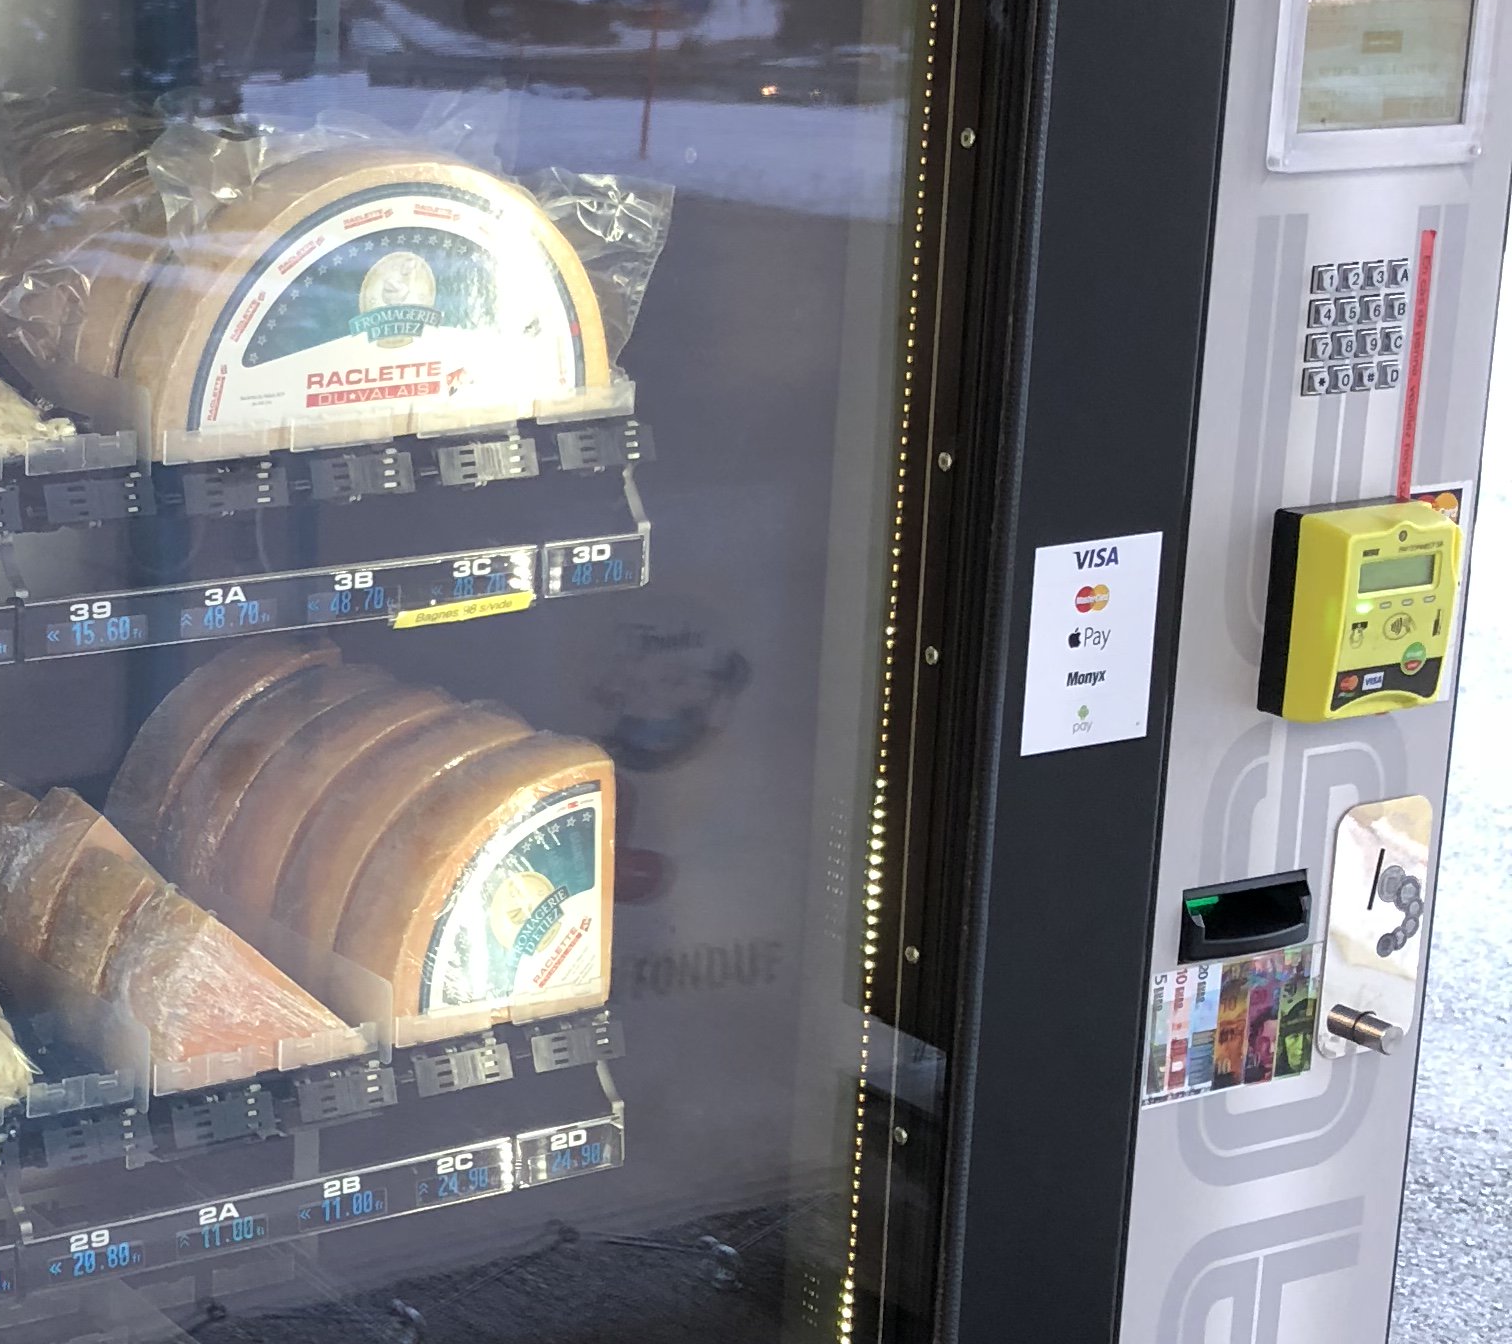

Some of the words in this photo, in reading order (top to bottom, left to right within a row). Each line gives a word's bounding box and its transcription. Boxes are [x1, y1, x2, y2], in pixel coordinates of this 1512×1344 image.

[353, 308, 440, 336] FROMAGERIE
[305, 361, 442, 390] RACLETTE
[318, 392, 348, 406] DU
[357, 383, 430, 403] VALAIS
[572, 543, 611, 564] 3D
[1073, 546, 1119, 570] VISA
[452, 558, 492, 579] 3C
[571, 559, 624, 586] 48.70
[333, 570, 374, 592] 3B
[204, 585, 248, 607] 3A
[329, 584, 386, 616] 48.70
[69, 601, 113, 623] 39
[203, 598, 260, 631] 48.70
[414, 608, 459, 624] Bagnes
[71, 615, 132, 648] 15.60
[1084, 627, 1112, 650] Pay
[1066, 669, 1107, 687] Monyx
[1072, 719, 1093, 735] pay
[1154, 974, 1168, 987] 5
[1175, 968, 1188, 985] 10
[1197, 965, 1210, 981] 20
[549, 1129, 588, 1151] 2D
[436, 1152, 474, 1175] 2C
[323, 1176, 362, 1198] 2B
[198, 1202, 240, 1226] 2A
[321, 1190, 374, 1223] 11.00
[69, 1229, 111, 1253] 29
[201, 1215, 254, 1249] 11.00
[72, 1241, 131, 1277] 20.80
